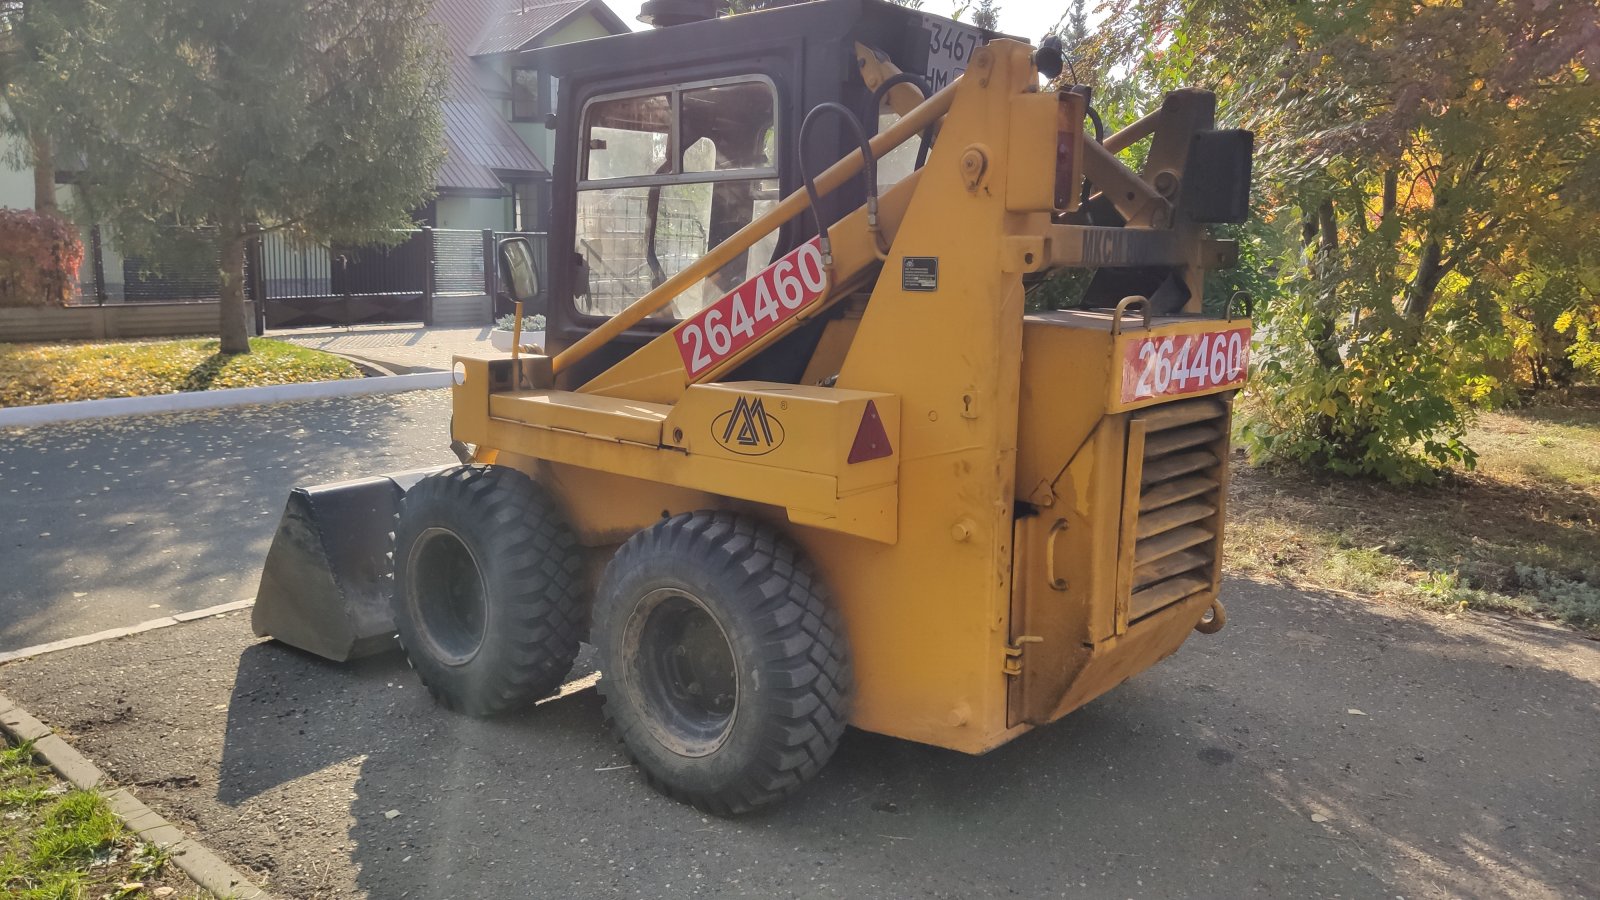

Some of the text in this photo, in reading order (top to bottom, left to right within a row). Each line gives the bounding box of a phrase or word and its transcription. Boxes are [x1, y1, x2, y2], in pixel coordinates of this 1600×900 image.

[929, 23, 976, 64] 3467
[682, 243, 826, 373] 264460
[1135, 331, 1242, 397] 264460
